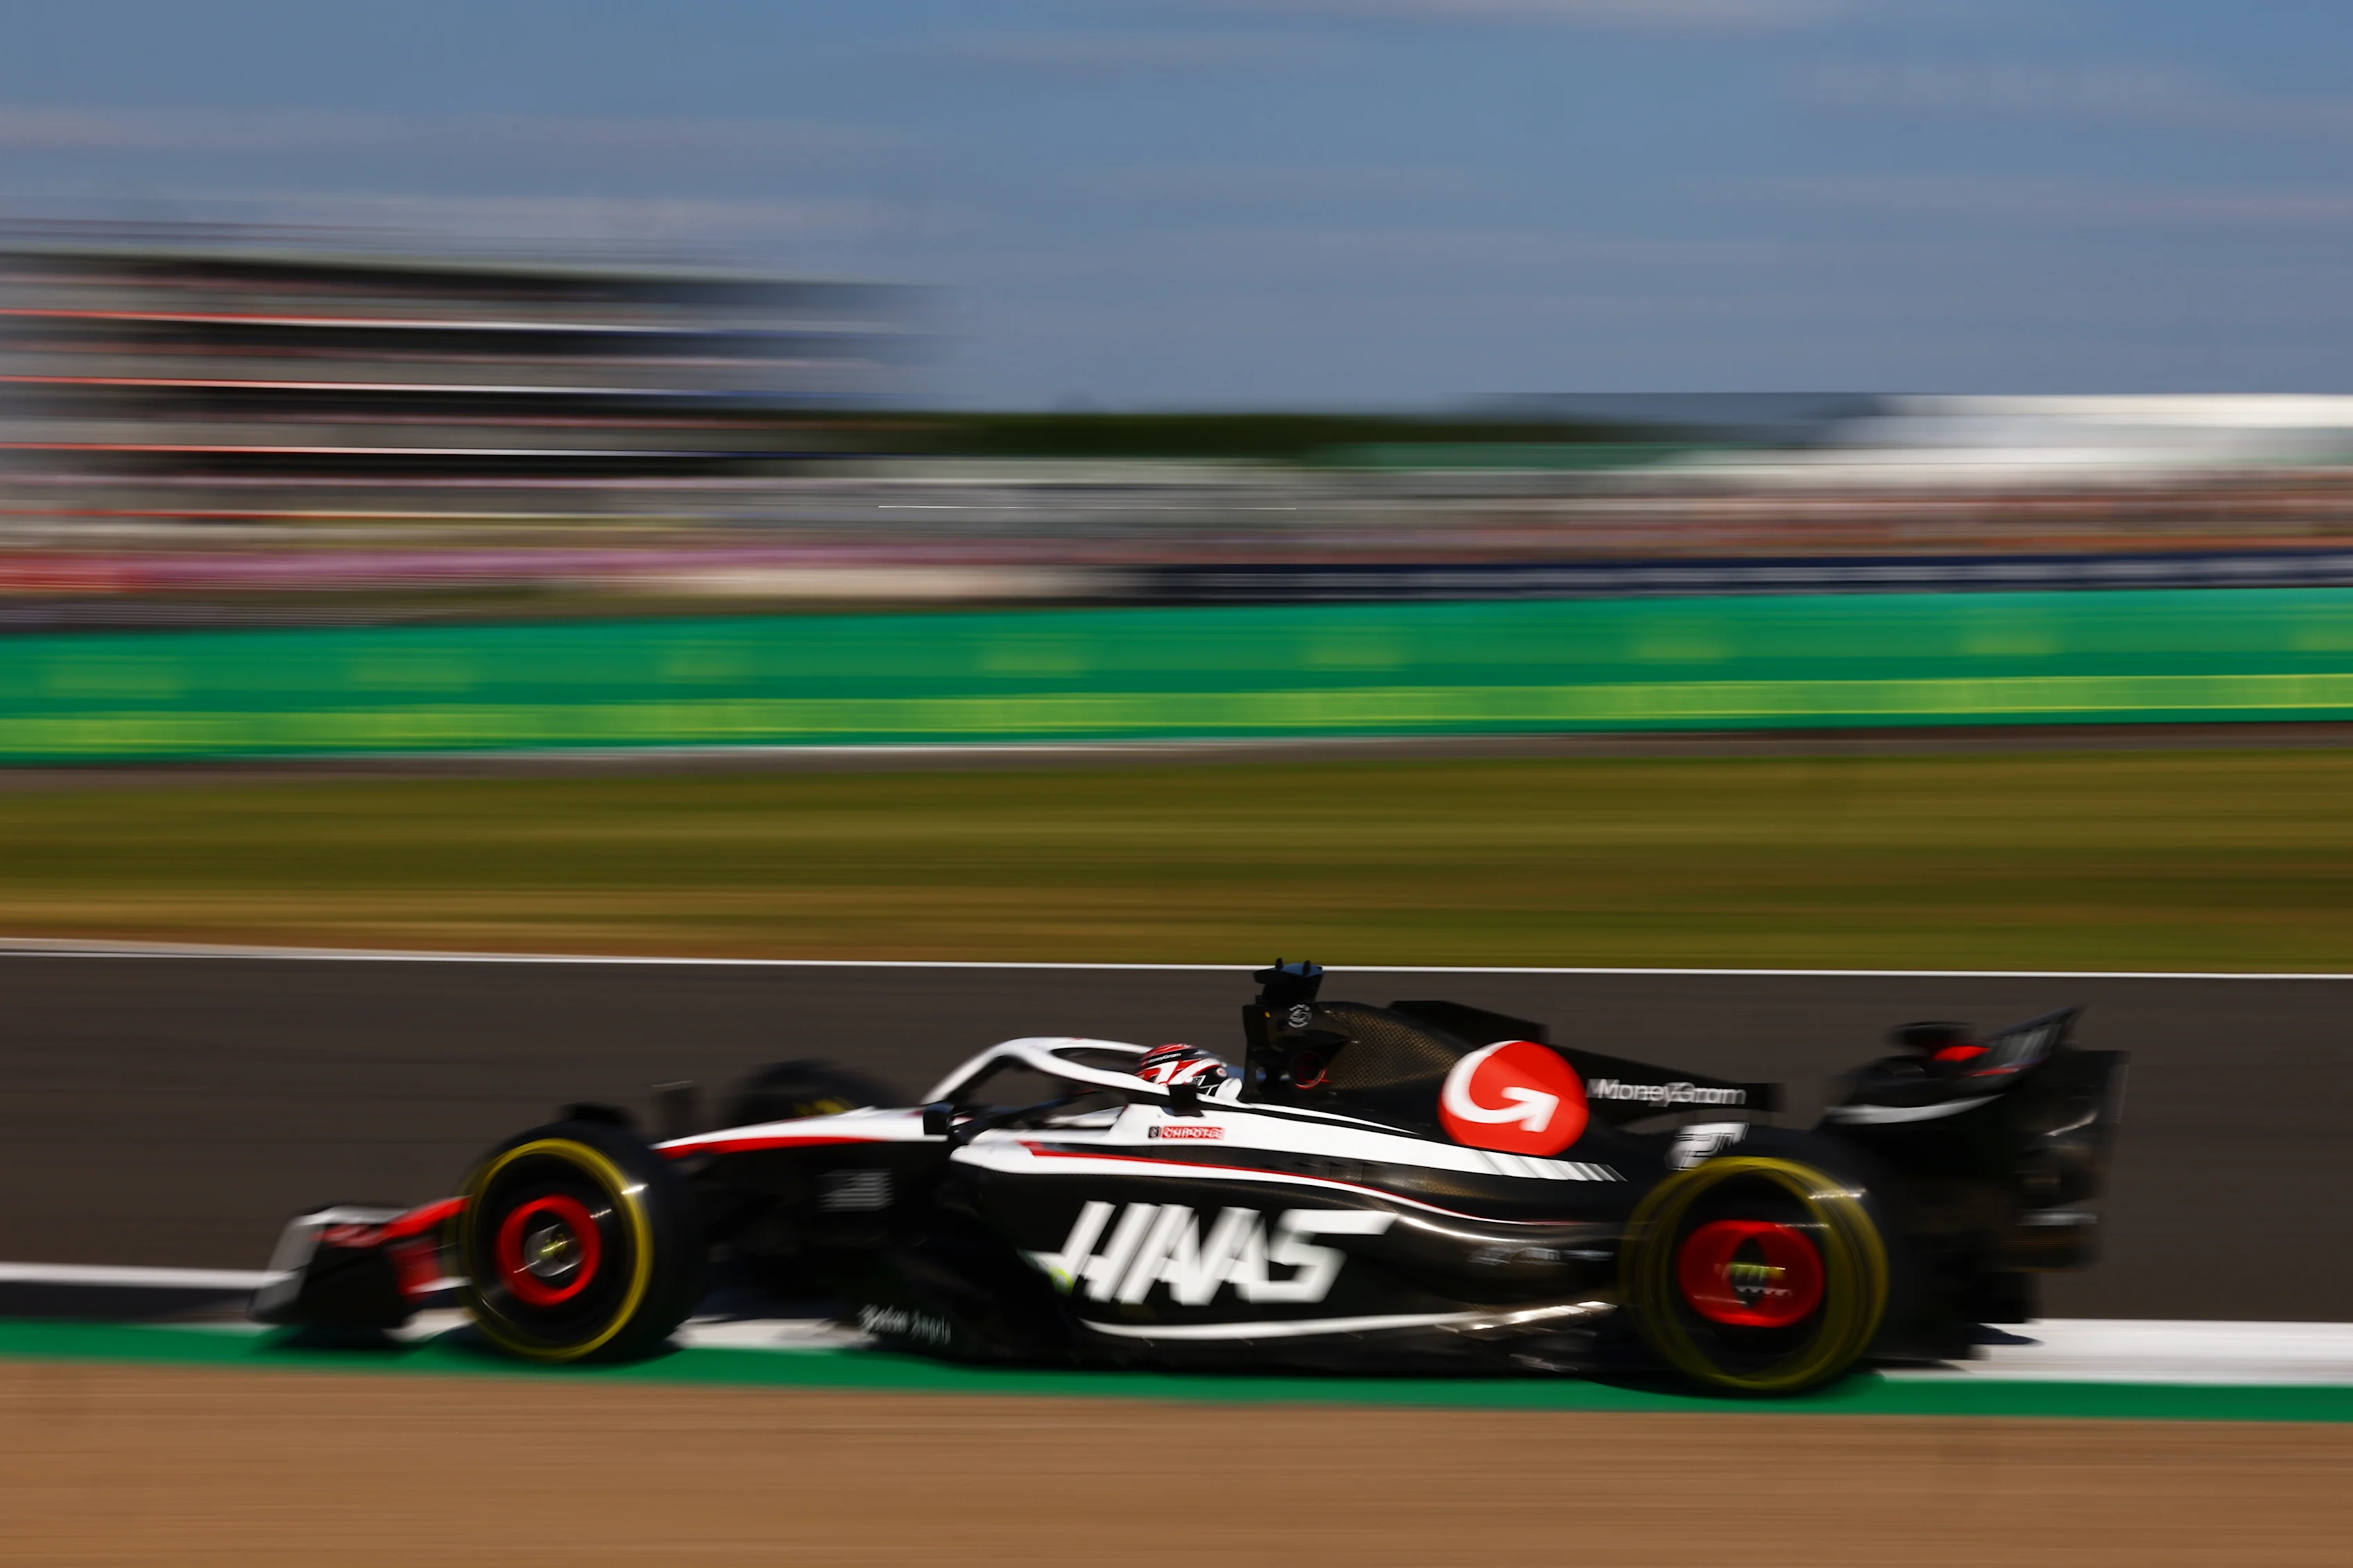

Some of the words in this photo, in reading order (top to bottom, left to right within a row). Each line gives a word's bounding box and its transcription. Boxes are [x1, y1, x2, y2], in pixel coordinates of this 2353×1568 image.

[1586, 1078, 1746, 1107] MoneyGram
[1163, 1127, 1223, 1139] CHIPOTLE
[1017, 1200, 1398, 1306] HAAS
